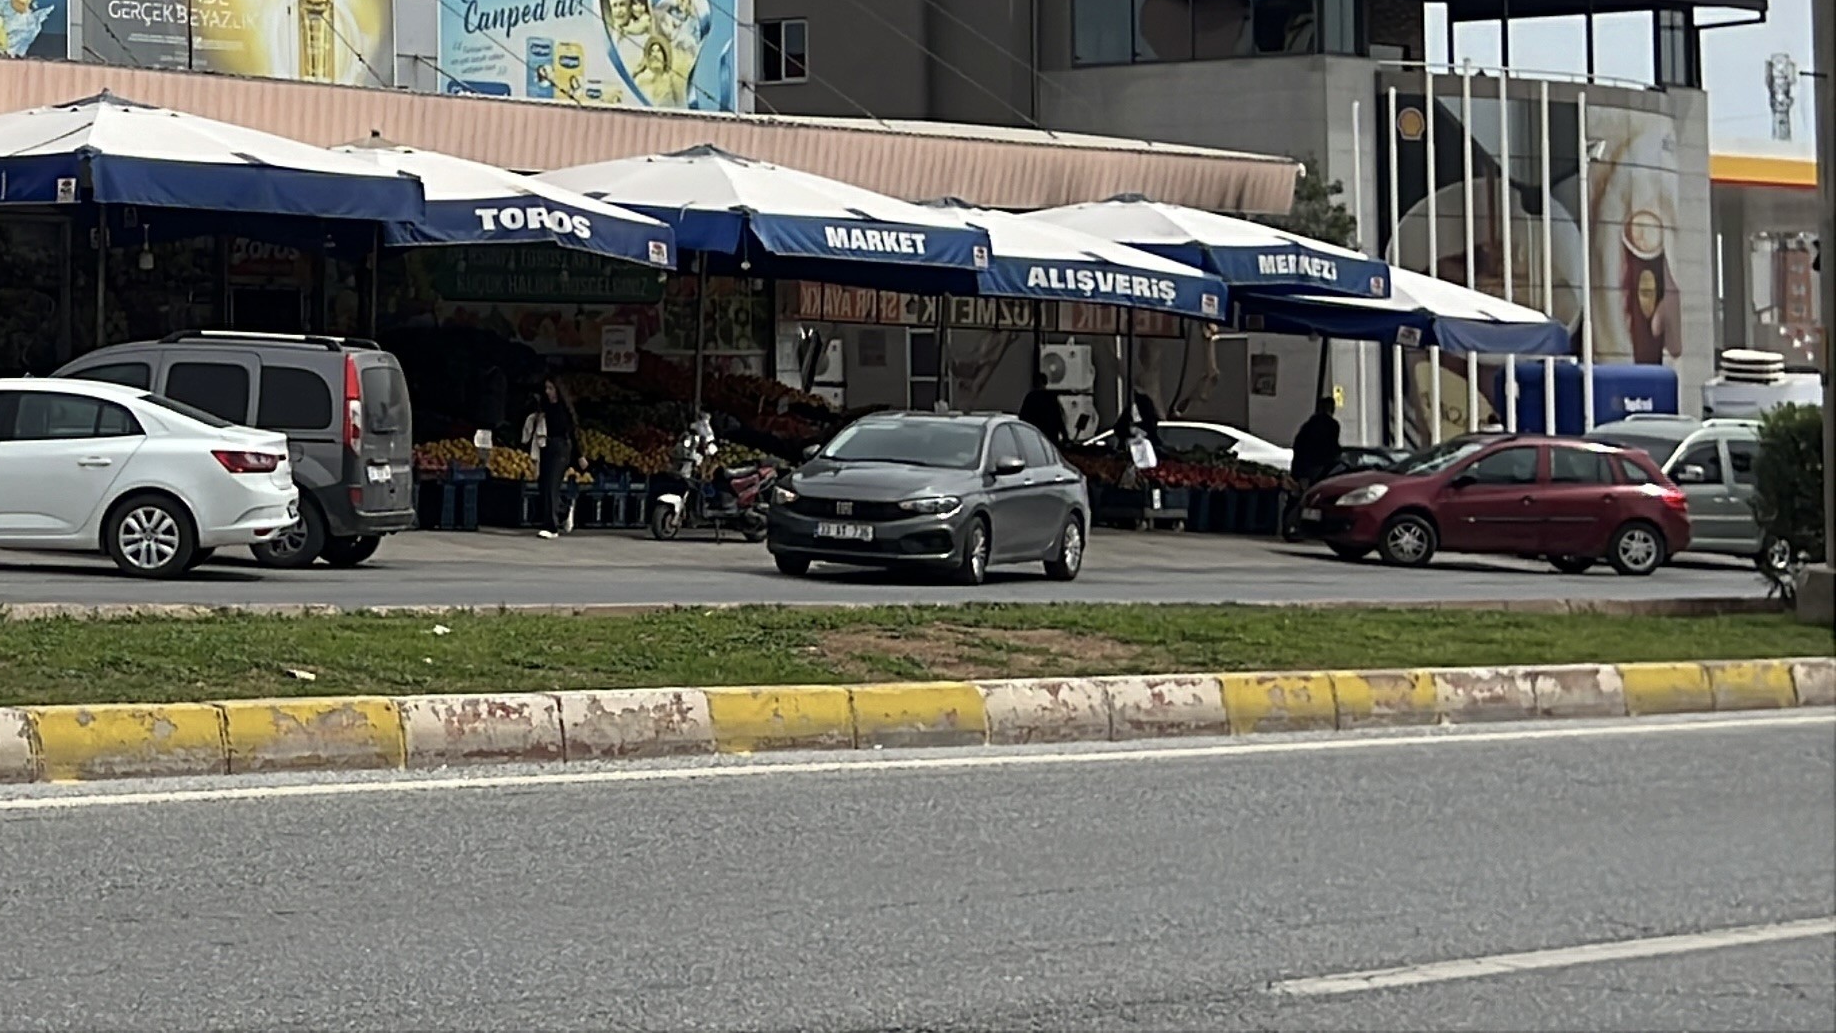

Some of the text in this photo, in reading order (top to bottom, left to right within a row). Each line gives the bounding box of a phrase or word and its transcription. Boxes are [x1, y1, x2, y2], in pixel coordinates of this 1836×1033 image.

[107, 0, 174, 27] GERÇEK
[475, 207, 592, 240] TOROS
[825, 225, 927, 256] MARKET
[1027, 266, 1177, 305] ALIŞVERİŞ
